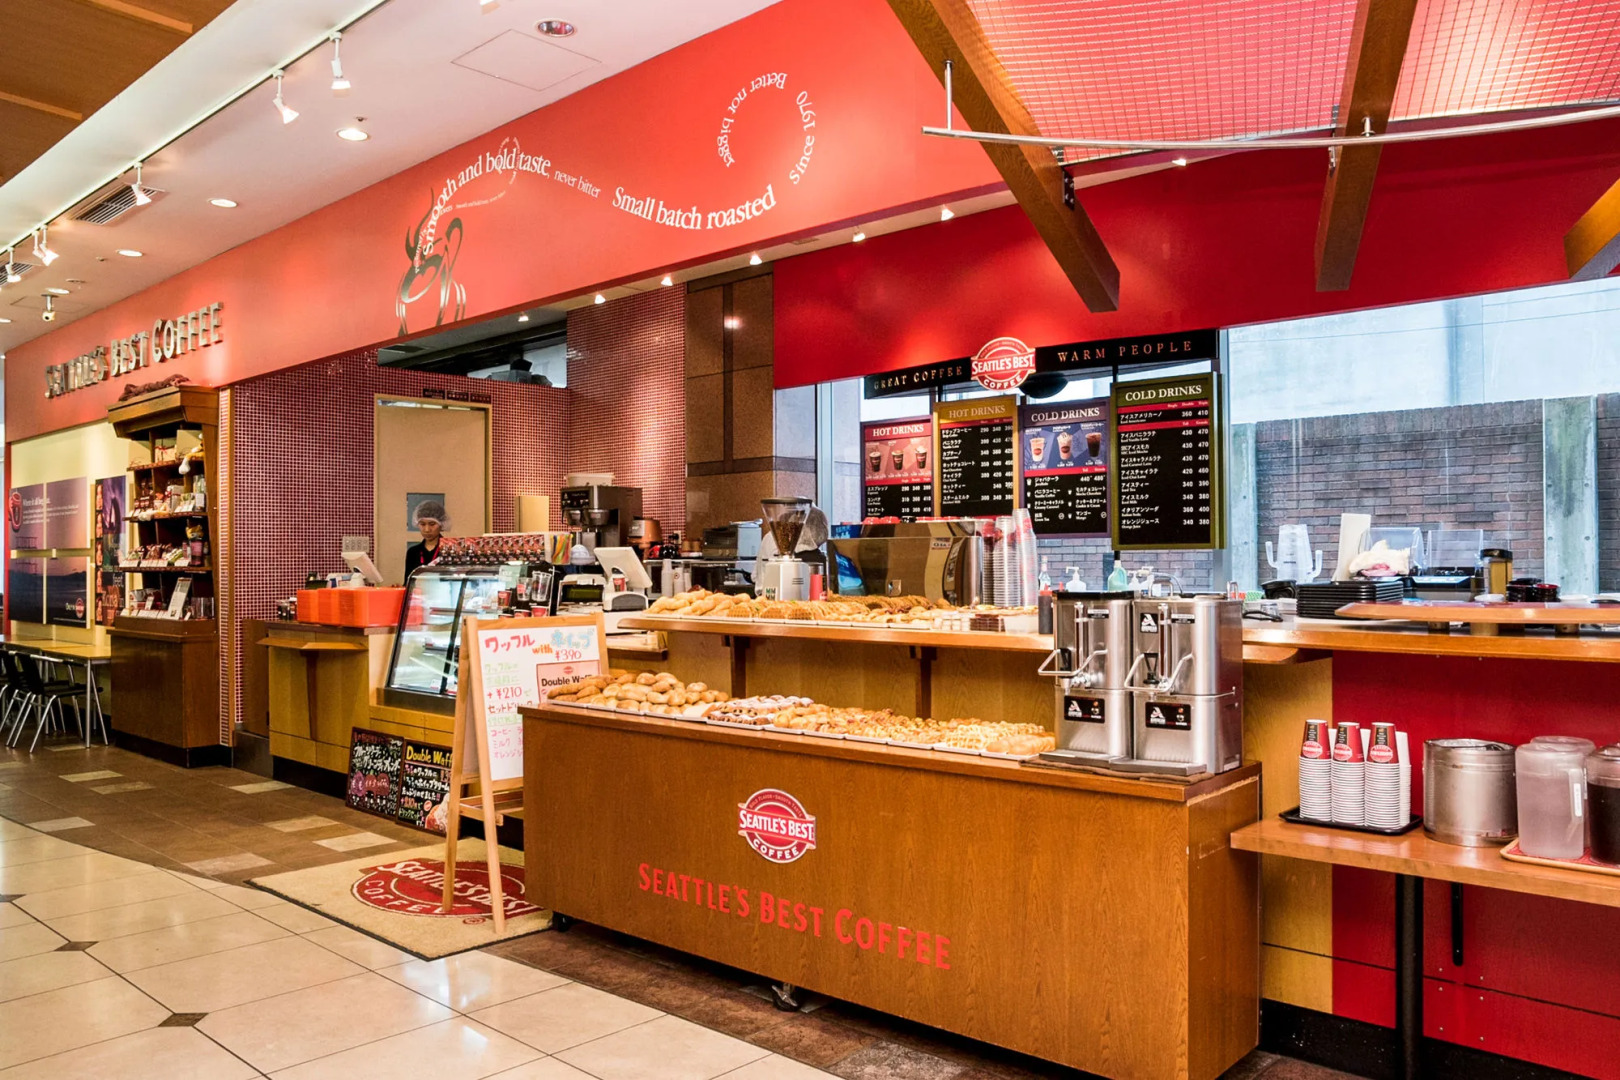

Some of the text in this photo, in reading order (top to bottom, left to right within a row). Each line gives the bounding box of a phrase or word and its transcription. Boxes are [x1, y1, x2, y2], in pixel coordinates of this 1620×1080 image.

[796, 90, 816, 130] 1970
[716, 72, 788, 168] Better not bigger
[457, 154, 482, 188] and
[485, 148, 516, 174] bold
[518, 152, 551, 178] taste,
[554, 170, 601, 198] never bitter
[612, 184, 776, 230] Small batch roasted
[111, 331, 150, 377] BEST
[152, 302, 224, 362] COFFEE
[1057, 340, 1192, 362] WARM PEOPLE
[972, 354, 1034, 374] SEATTLE'S BEST
[874, 366, 963, 390] GREAT COFFEE
[984, 375, 1022, 390] COFFEE
[1125, 385, 1202, 401] COLD DRINKS
[949, 405, 1005, 418] HOT DRINKS
[1031, 407, 1100, 422] COLD DRINKS
[1120, 412, 1162, 420] アイスアメリカーノ
[873, 424, 924, 436] HOT DRINKS
[484, 634, 535, 653] ワッフル
[532, 644, 553, 654] with
[556, 649, 582, 661] ¥390
[541, 677, 570, 686] Double
[496, 686, 522, 700] ¥210
[488, 700, 532, 714] セットド
[406, 746, 431, 763] Double
[740, 810, 814, 840] SEATTLE'S BEST
[753, 838, 799, 859] COFFEE
[638, 863, 951, 970] SEATTLE'S BEST COFFEE
